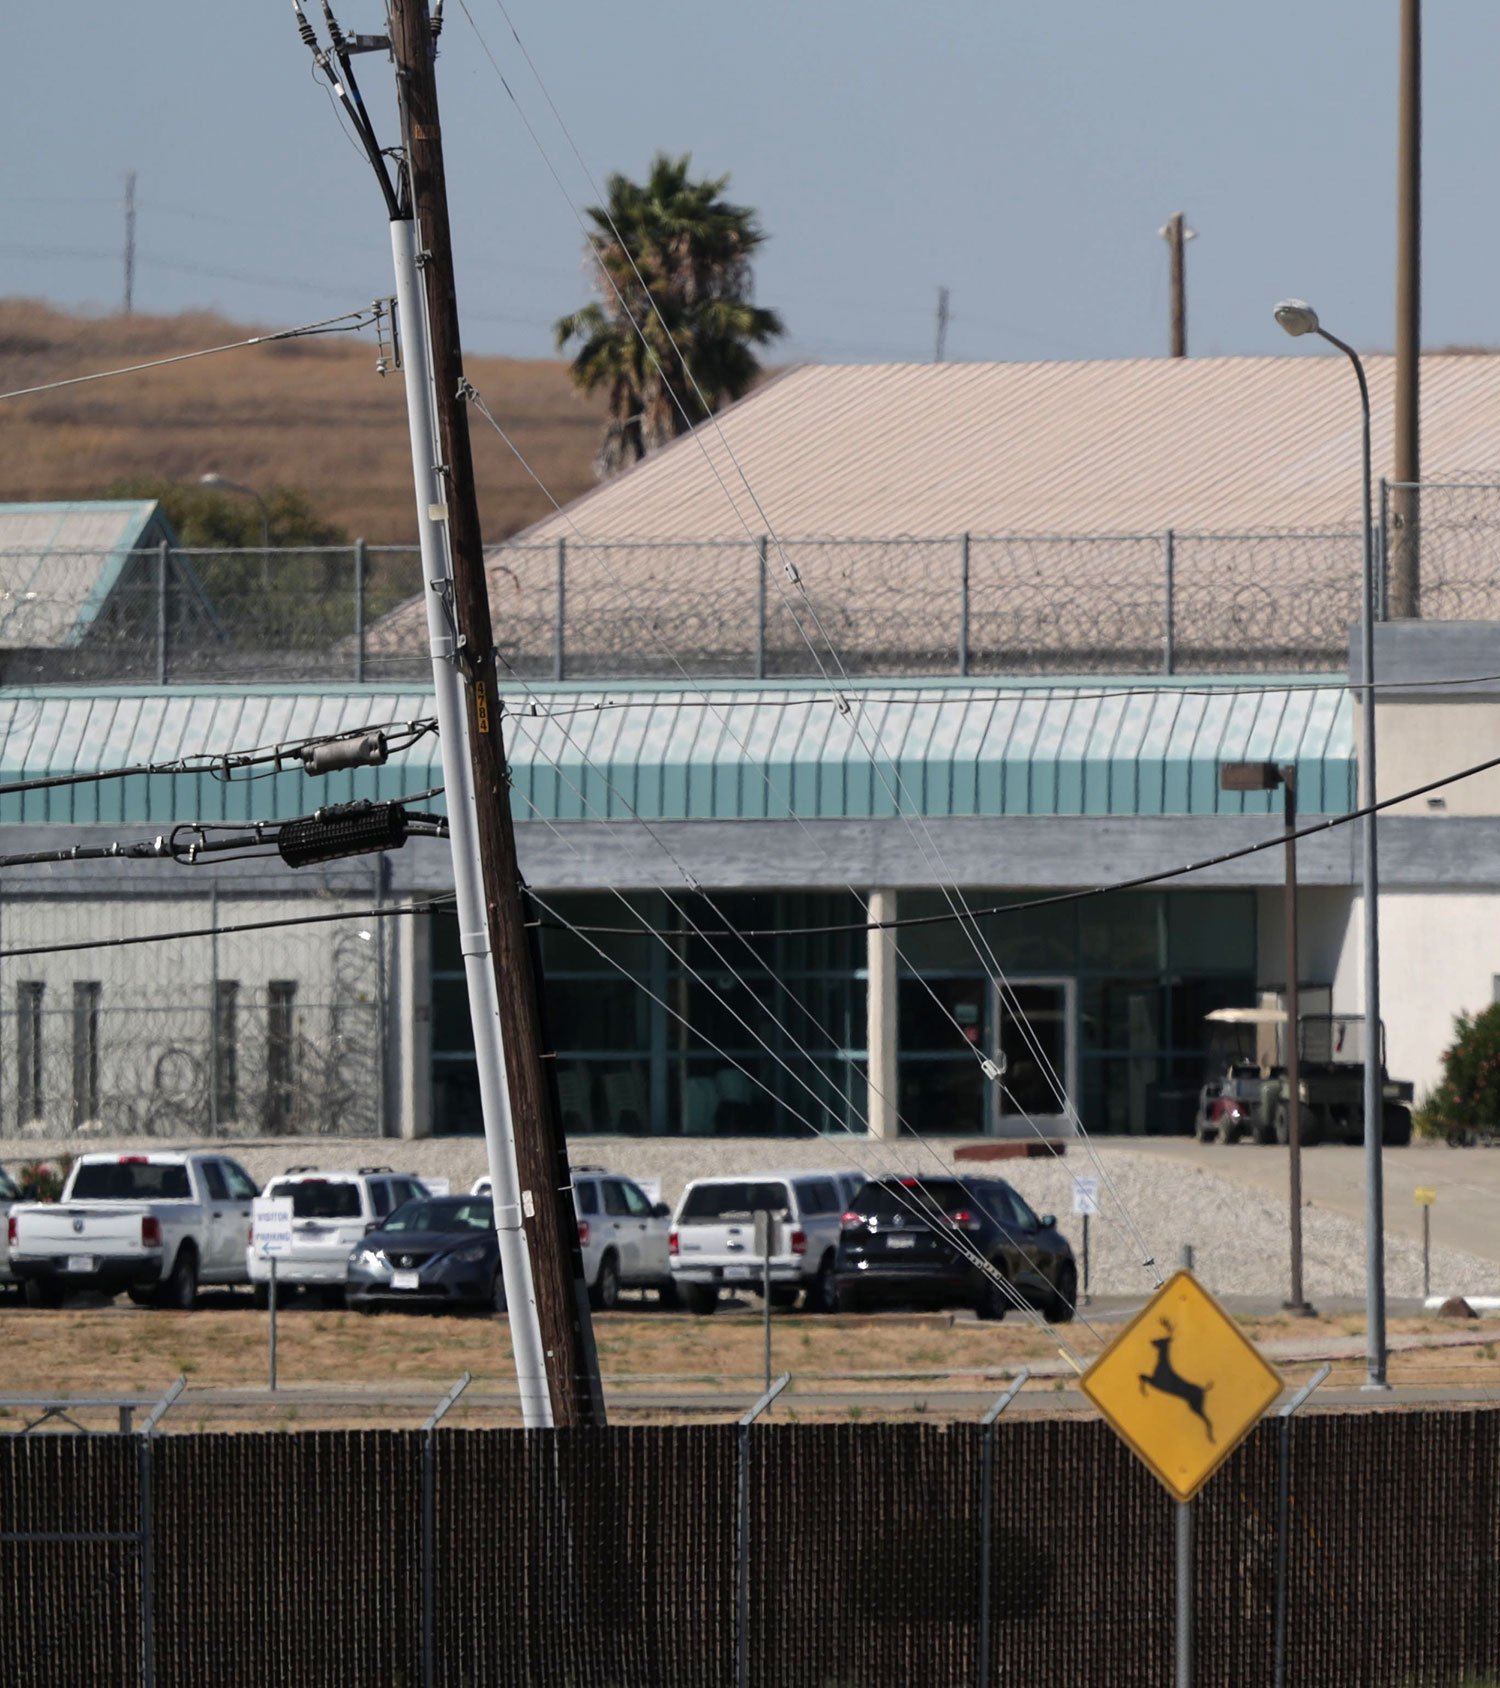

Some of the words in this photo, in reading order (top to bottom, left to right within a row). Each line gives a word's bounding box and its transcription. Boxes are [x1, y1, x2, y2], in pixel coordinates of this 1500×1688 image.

[477, 681, 489, 732] 4784
[257, 1211, 289, 1222] VISITOR
[255, 1231, 291, 1241] PARKING
